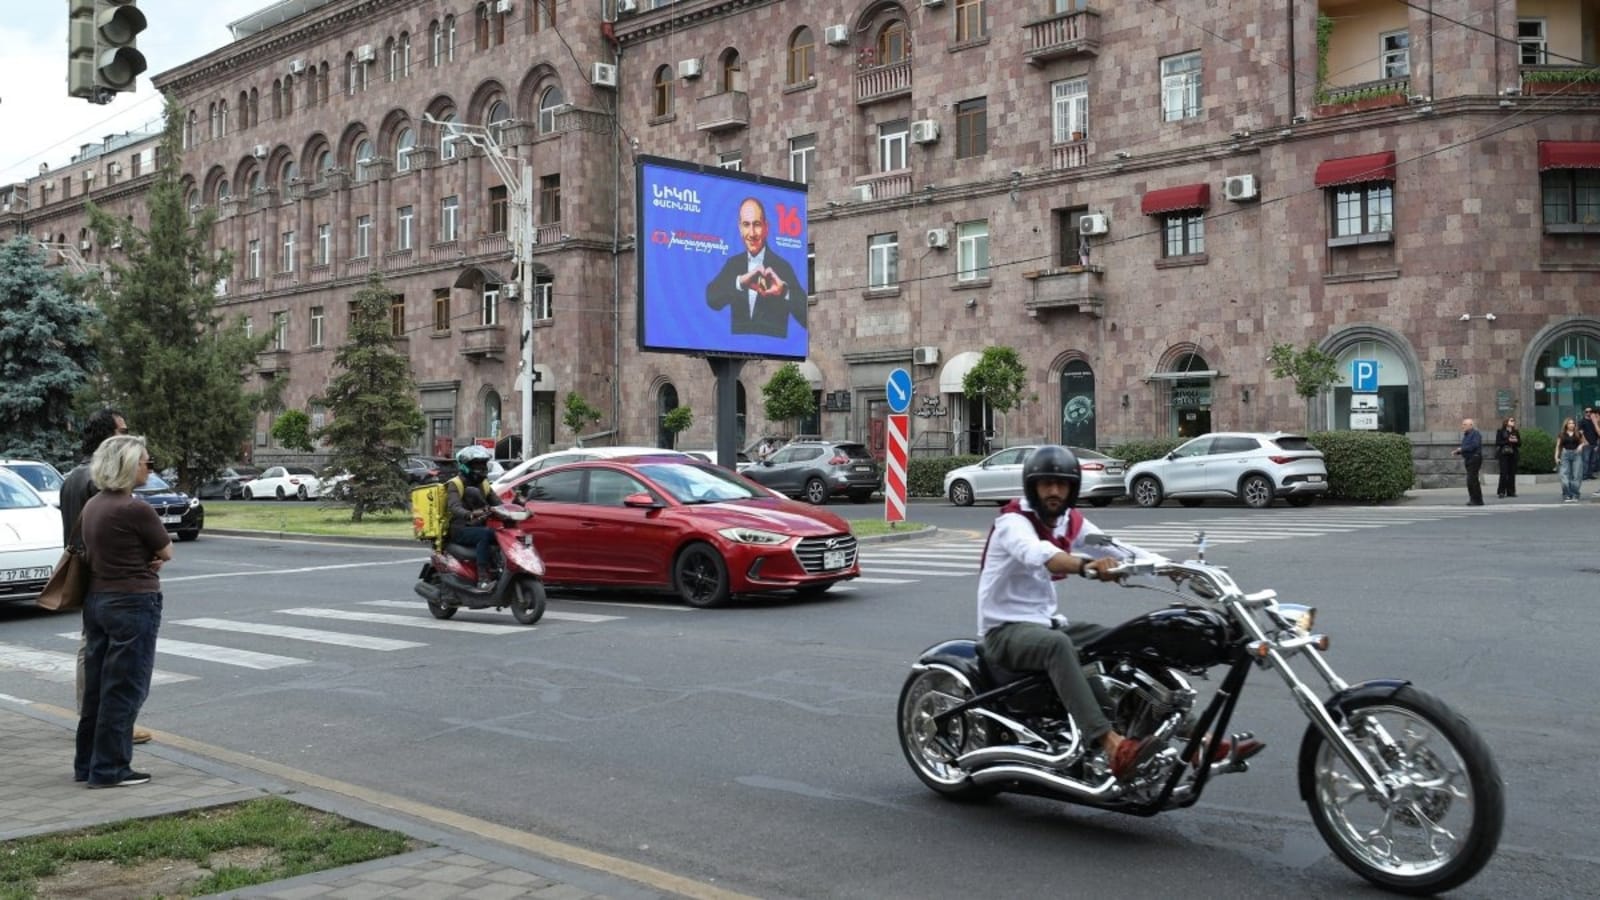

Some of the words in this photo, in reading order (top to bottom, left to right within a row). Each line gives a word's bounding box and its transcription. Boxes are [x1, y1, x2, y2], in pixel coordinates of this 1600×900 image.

[652, 184, 701, 204] ՆԻԿՈԼ
[652, 199, 701, 213] ՓԱՇԻՆՅԱՆ
[776, 203, 802, 237] 16
[1358, 362, 1373, 389] P
